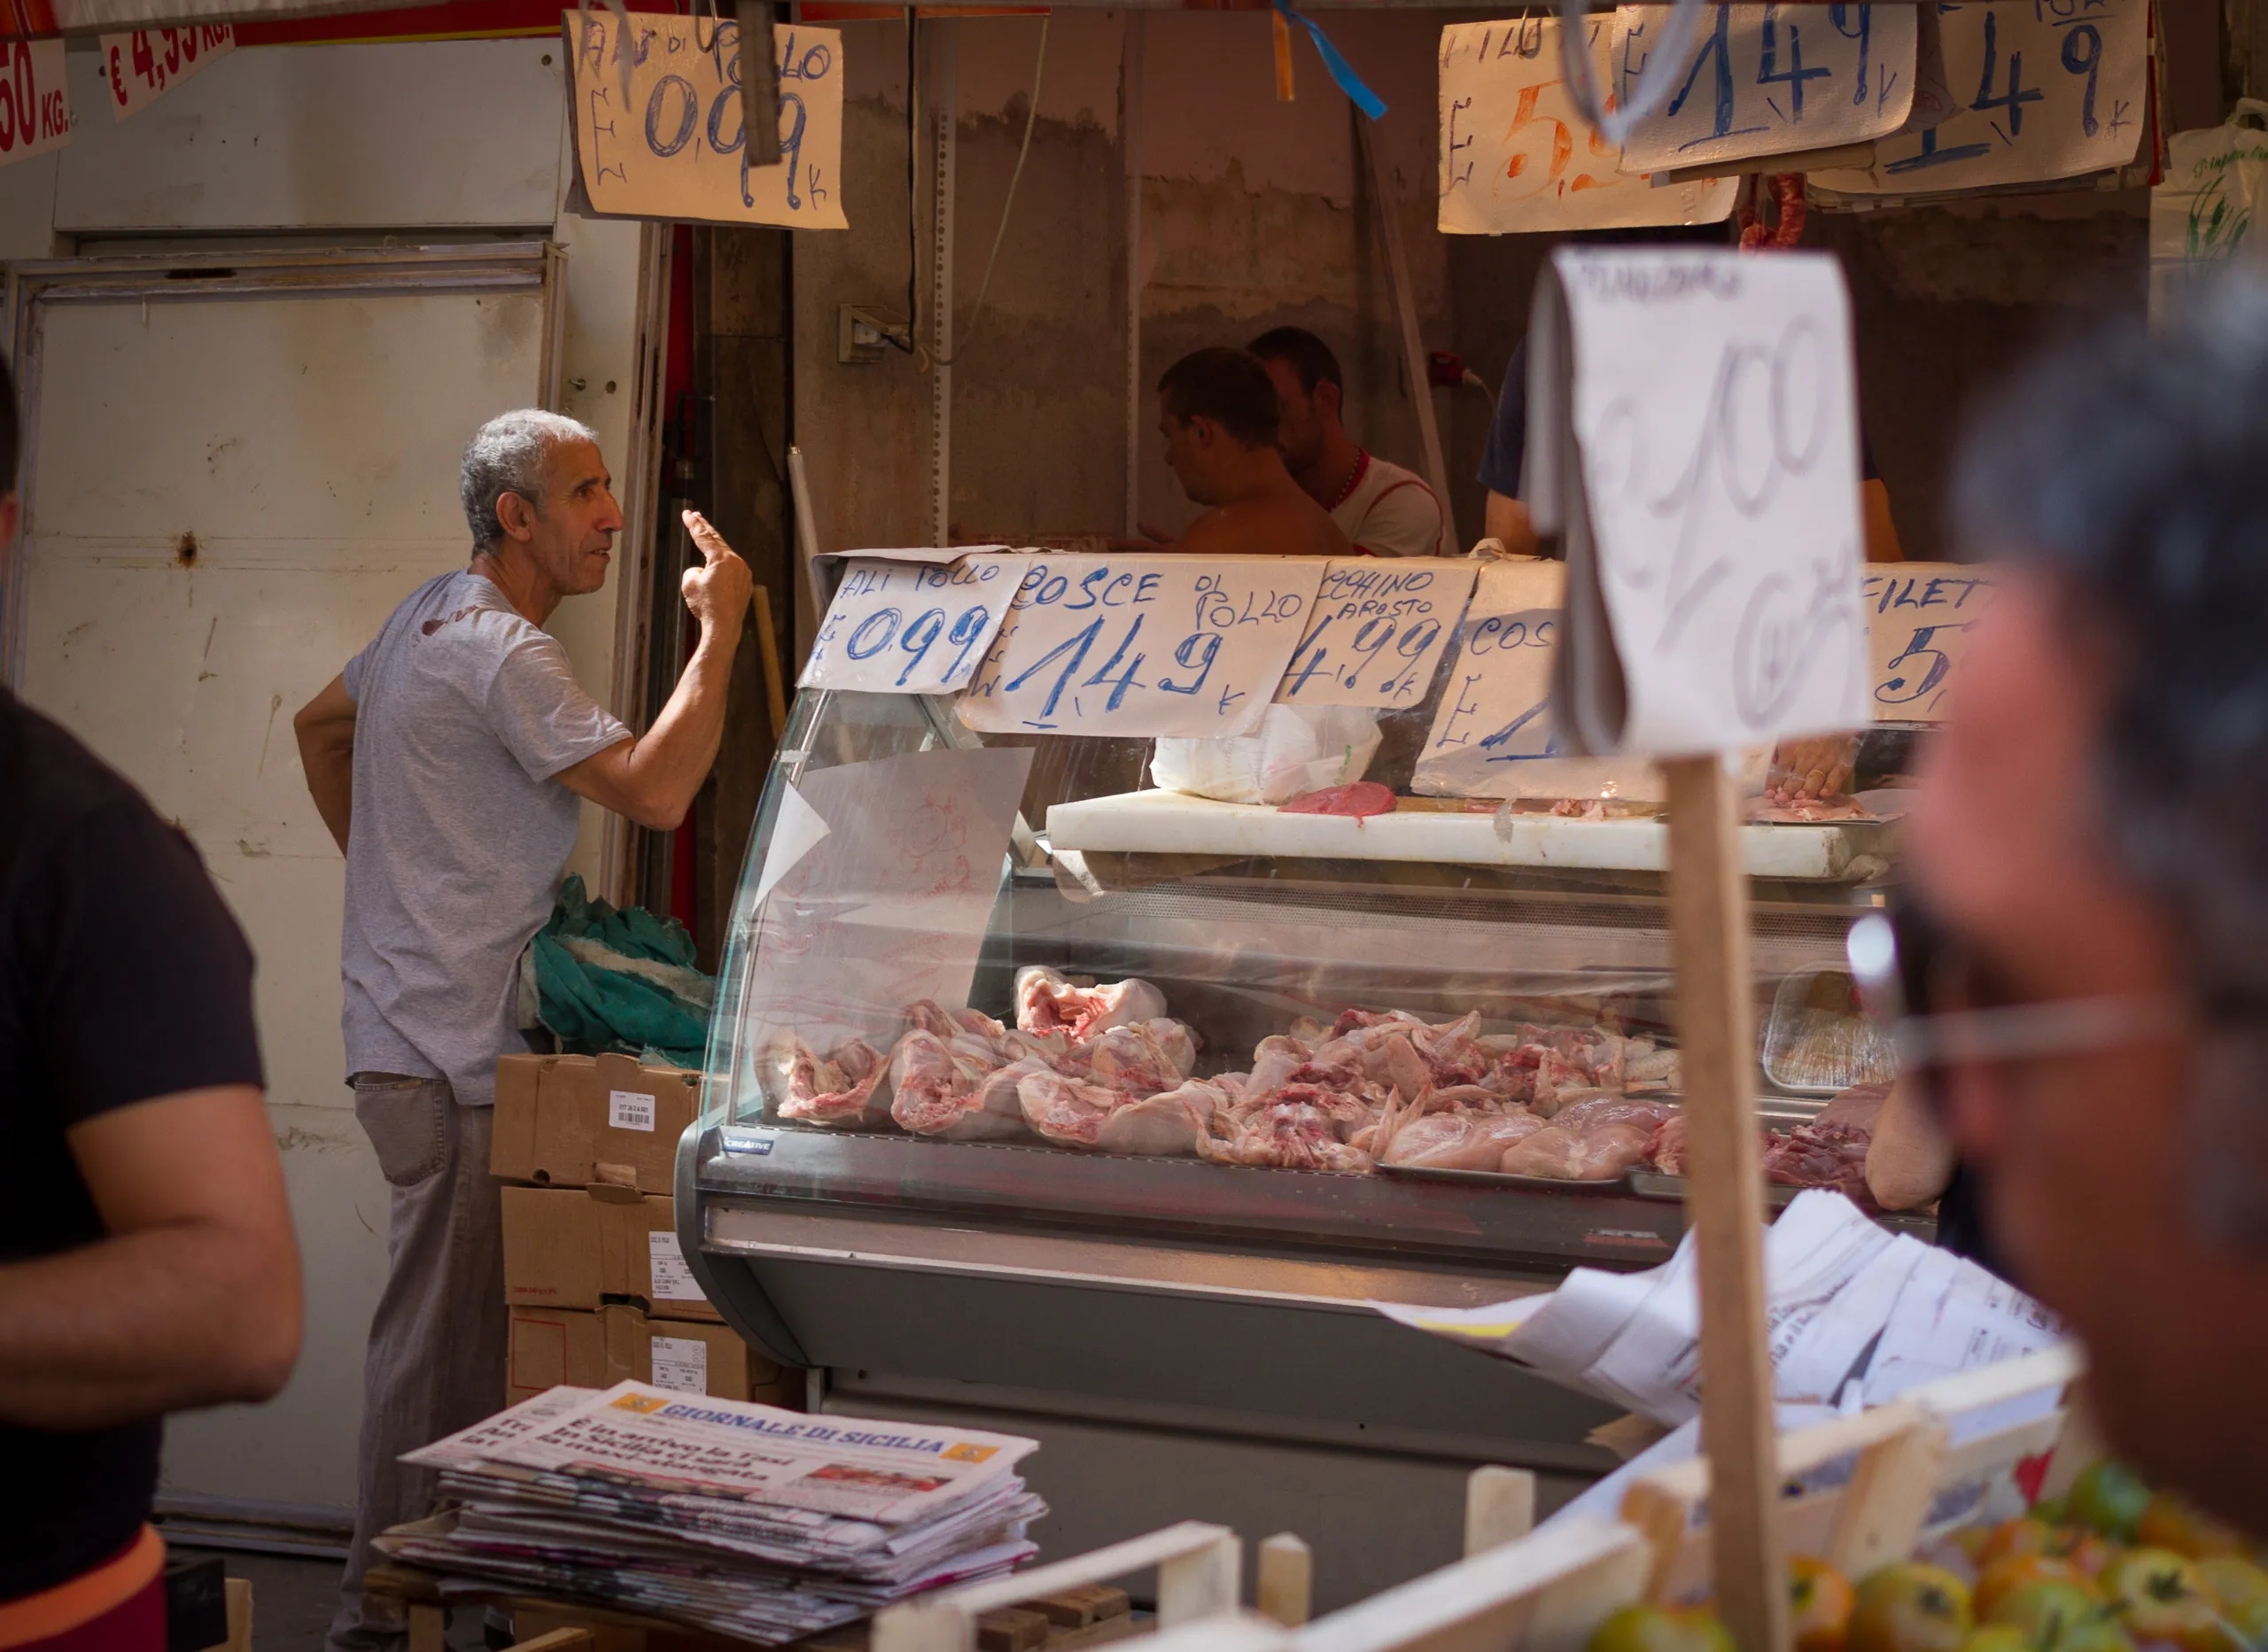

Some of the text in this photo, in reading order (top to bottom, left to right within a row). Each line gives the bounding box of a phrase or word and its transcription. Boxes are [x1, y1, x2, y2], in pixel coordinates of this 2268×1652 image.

[110, 45, 128, 106] €
[42, 89, 68, 139] KG.
[1196, 590, 1302, 630] POLLO
[847, 604, 990, 686] 0,99
[1005, 614, 1223, 729] 1,49
[661, 1403, 946, 1454] GIORNALE DI SICILIA
